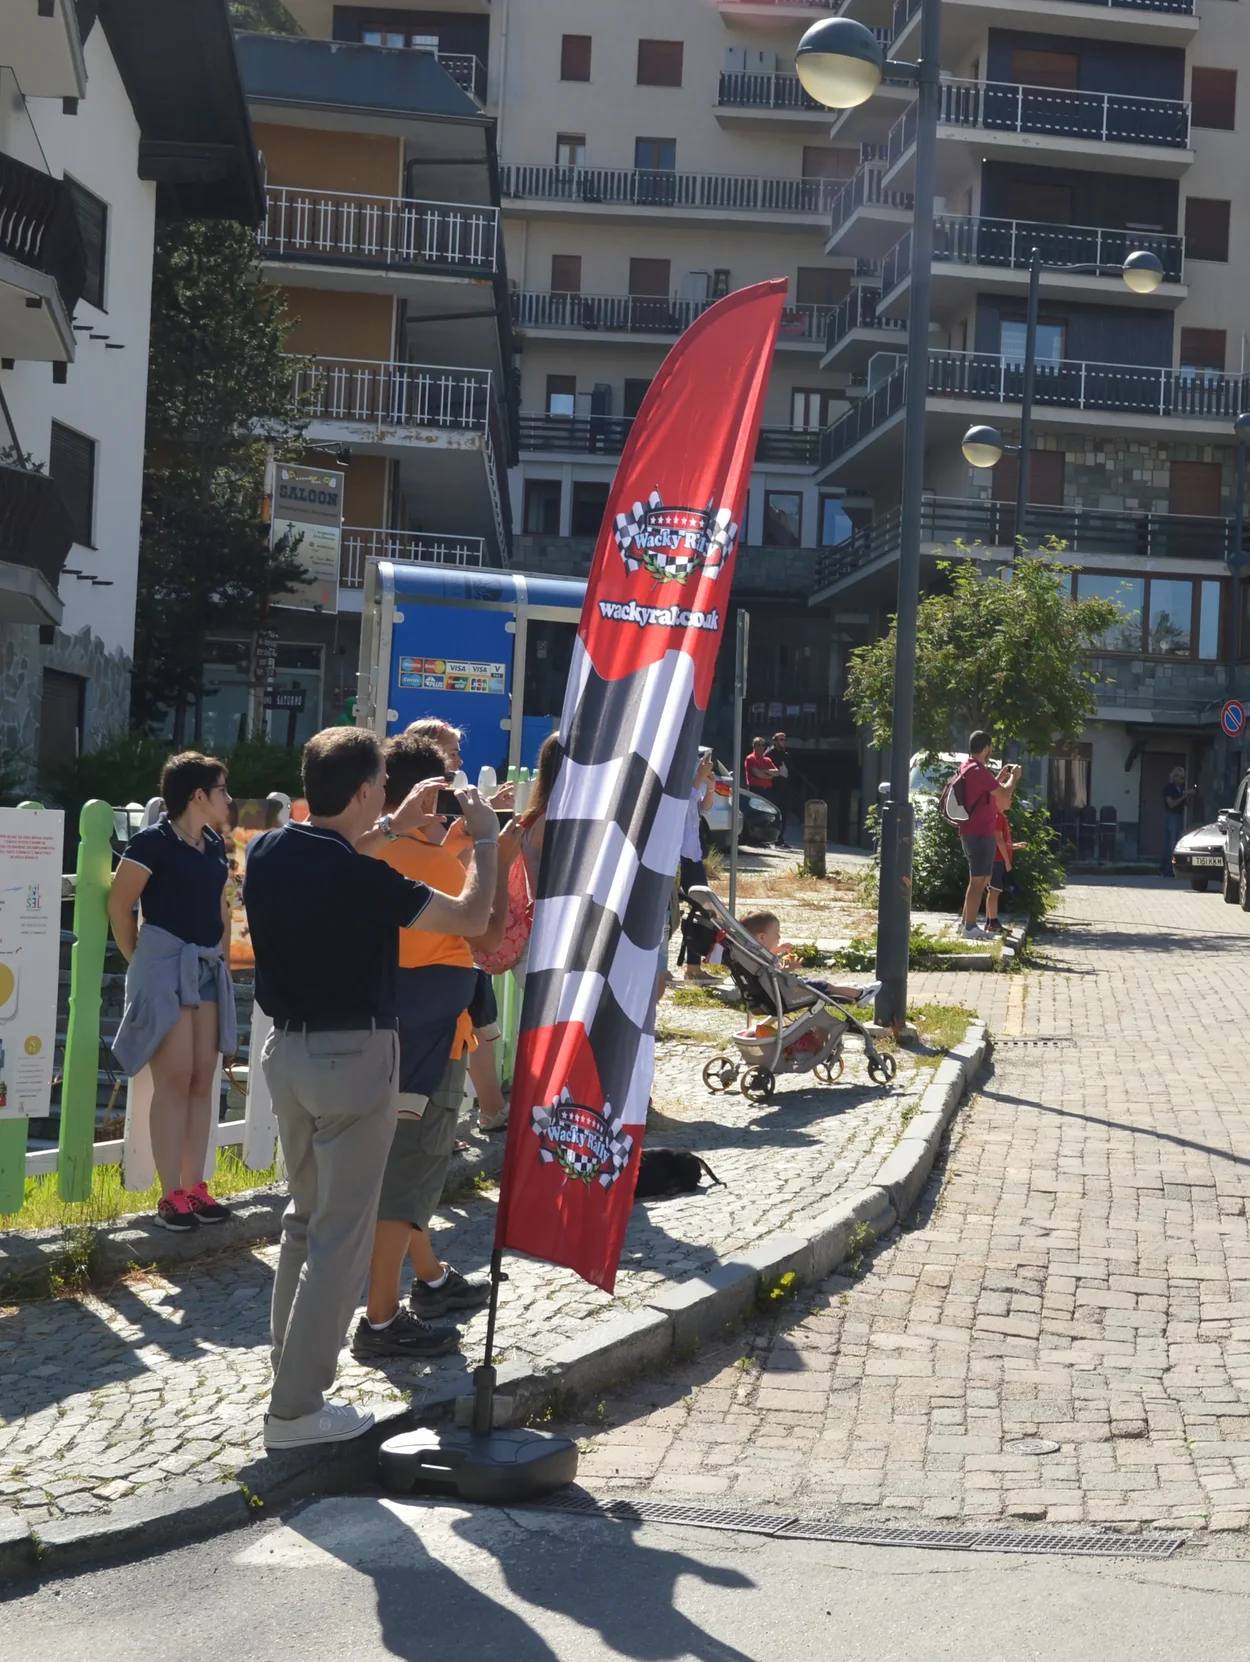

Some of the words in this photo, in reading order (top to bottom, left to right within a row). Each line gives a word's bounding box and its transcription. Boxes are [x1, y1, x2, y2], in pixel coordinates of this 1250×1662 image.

[279, 484, 339, 507] SALOON
[634, 527, 682, 550] Wacky
[450, 664, 467, 672] VISA
[472, 665, 488, 673] VISA
[430, 680, 444, 688] PLUS
[276, 694, 303, 706] SATURNO
[547, 1125, 587, 1148] Wacky
[587, 1132, 611, 1164] Rally
